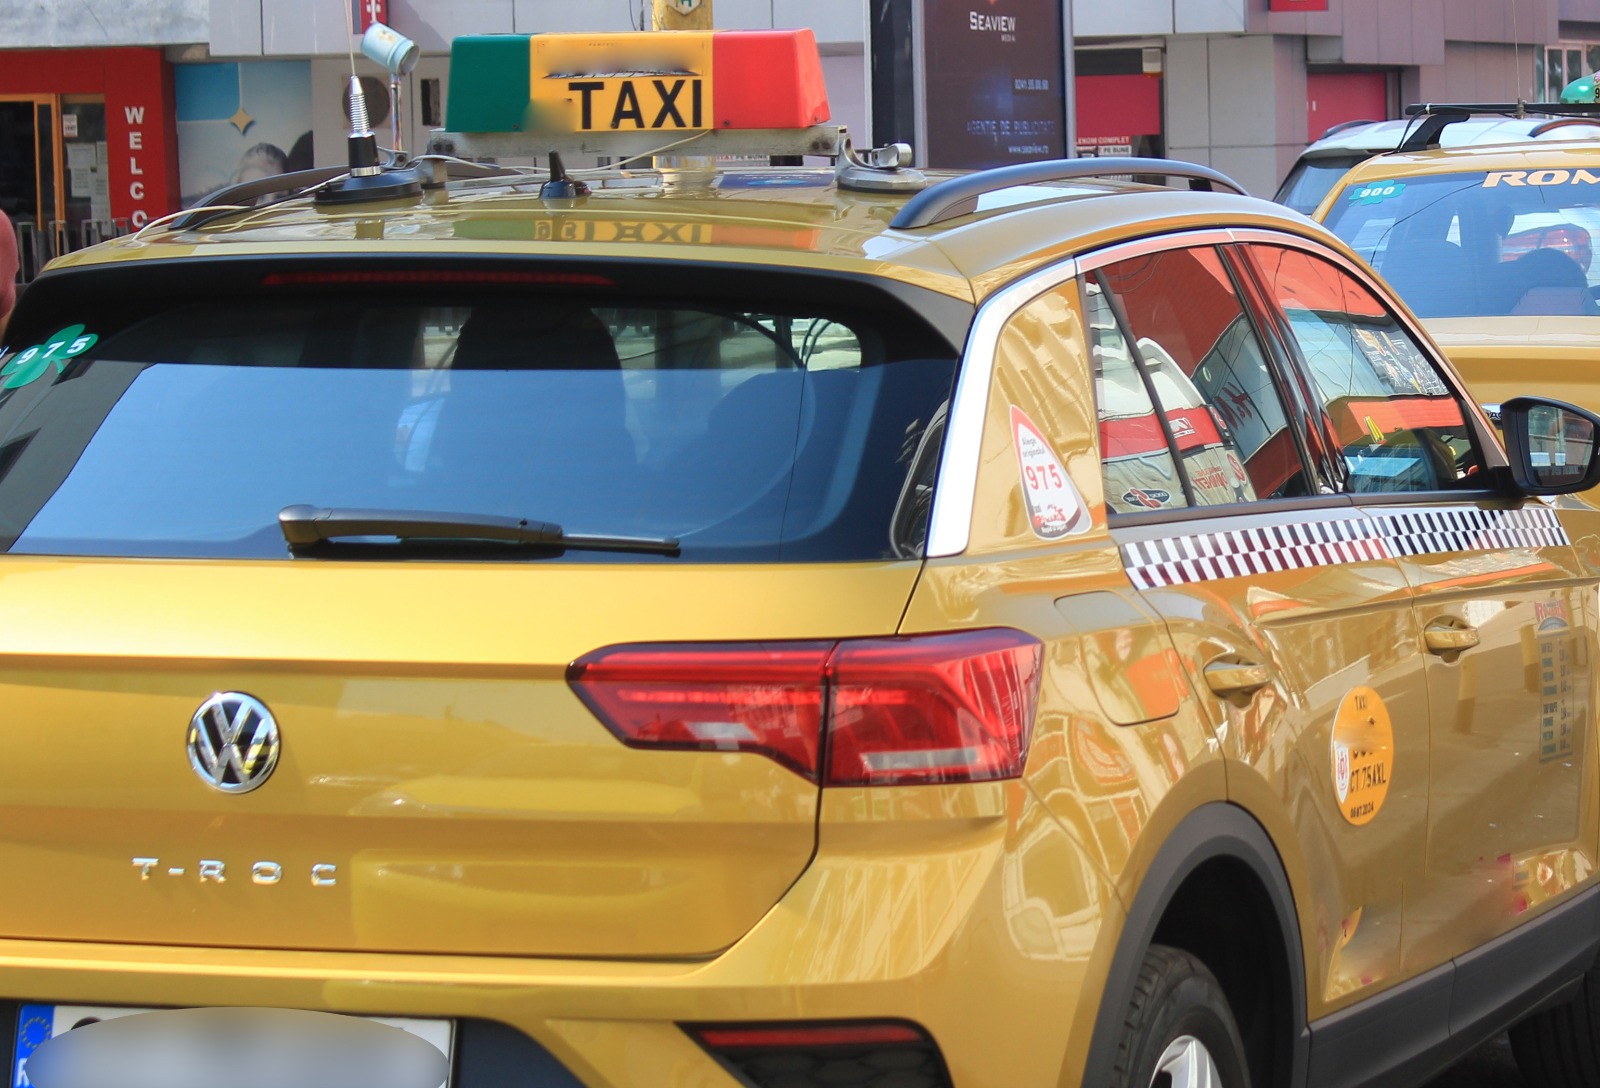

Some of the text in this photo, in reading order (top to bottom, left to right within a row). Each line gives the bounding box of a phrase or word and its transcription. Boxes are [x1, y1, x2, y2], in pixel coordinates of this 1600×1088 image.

[568, 79, 702, 130] TAXI
[16, 336, 92, 365] 975
[1025, 463, 1062, 490] 975
[1354, 694, 1368, 711] TAXI
